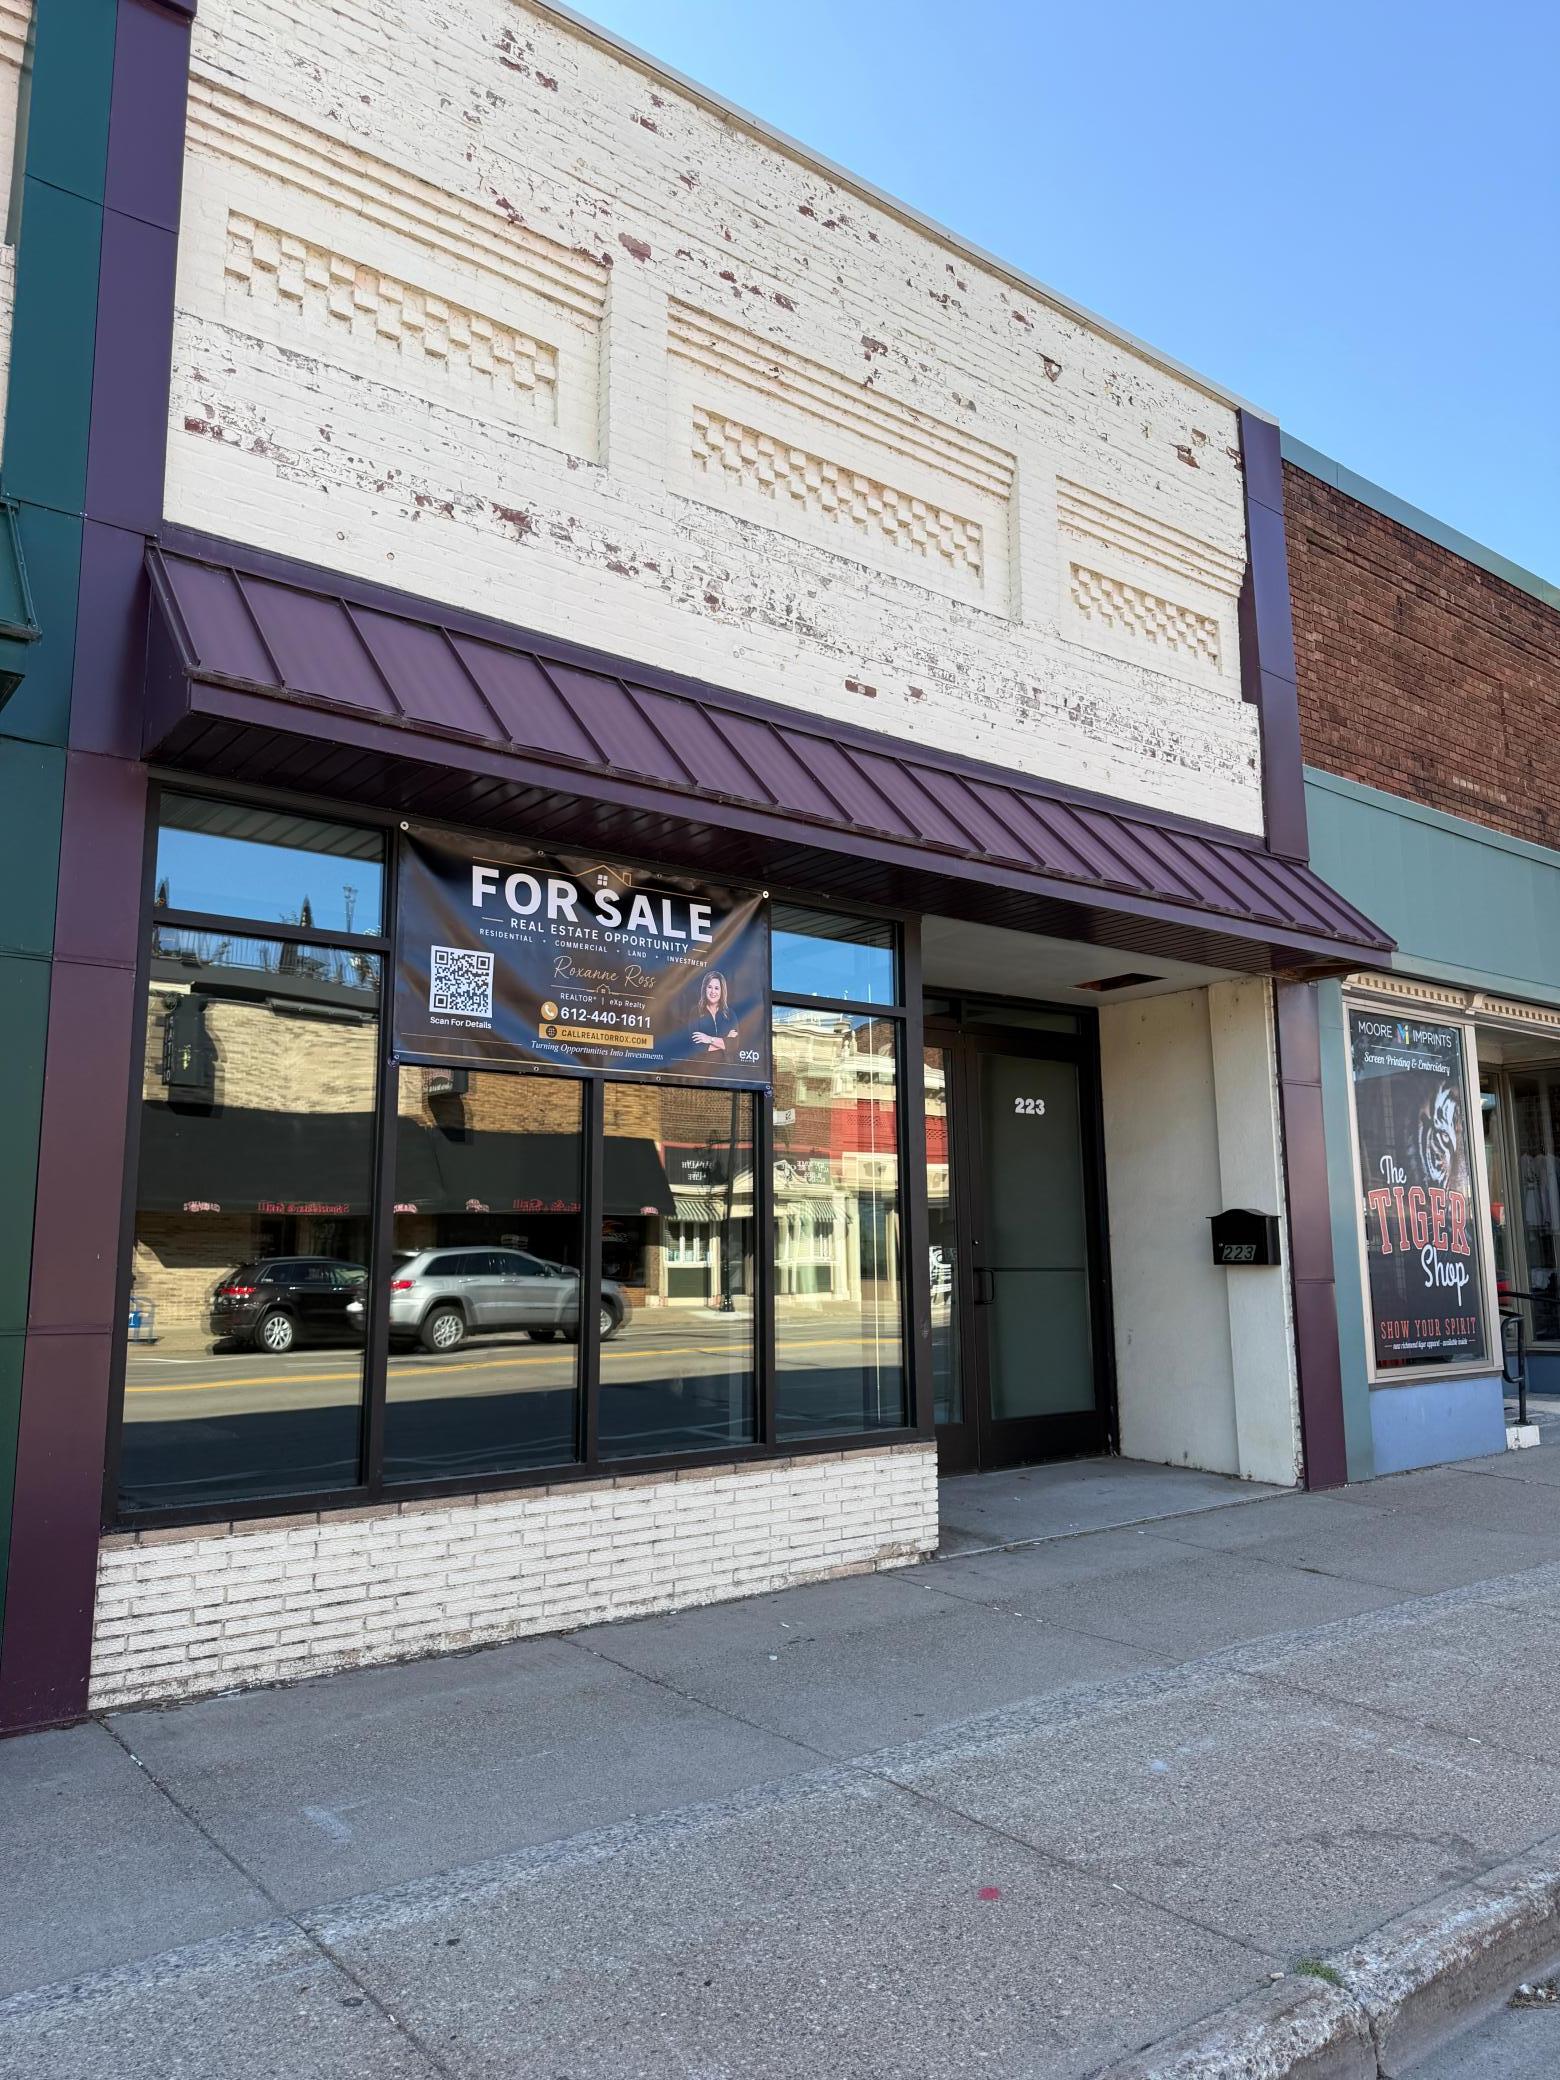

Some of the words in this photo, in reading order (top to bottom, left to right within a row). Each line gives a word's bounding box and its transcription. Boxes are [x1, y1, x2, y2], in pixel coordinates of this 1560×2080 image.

[472, 865, 578, 922] FOR
[594, 888, 713, 943] SALE
[479, 928, 533, 943] RESIDENTIAL
[555, 939, 608, 953] COMMERCIAL
[628, 950, 647, 958] LAND
[667, 955, 708, 968] INVESTMENT
[511, 918, 545, 933] REAL
[551, 924, 599, 940] ESTATE
[604, 931, 689, 954] OPPORTUNITY
[553, 955, 620, 981] Roxanne
[624, 964, 657, 989] Ross
[560, 1006, 651, 1029] 612-440-1611
[624, 1001, 646, 1010] Realty
[430, 1016, 449, 1025] Scan
[451, 1018, 463, 1027] For
[465, 1020, 492, 1029] Details
[1358, 1021, 1392, 1038] MOORE
[1413, 1029, 1452, 1047] IMPRINTS
[561, 1029, 647, 1045] CALLREALTORROX.COM
[531, 1040, 559, 1052] Turning
[561, 1044, 608, 1056] Opportunities
[610, 1048, 624, 1057] Into
[625, 1050, 664, 1060] Investments
[1364, 1052, 1384, 1064] Screen
[1386, 1055, 1410, 1070] Printing
[1418, 1060, 1450, 1076] Embroidery
[1014, 1097, 1046, 1115] 223
[1380, 1155, 1407, 1184] The
[1368, 1186, 1471, 1256] TIGER
[1224, 1246, 1254, 1259] 223
[1421, 1243, 1469, 1307] Shop
[1380, 1320, 1409, 1339] SHOW
[1415, 1318, 1441, 1337] YOUR
[1445, 1316, 1476, 1335] SPIRIT
